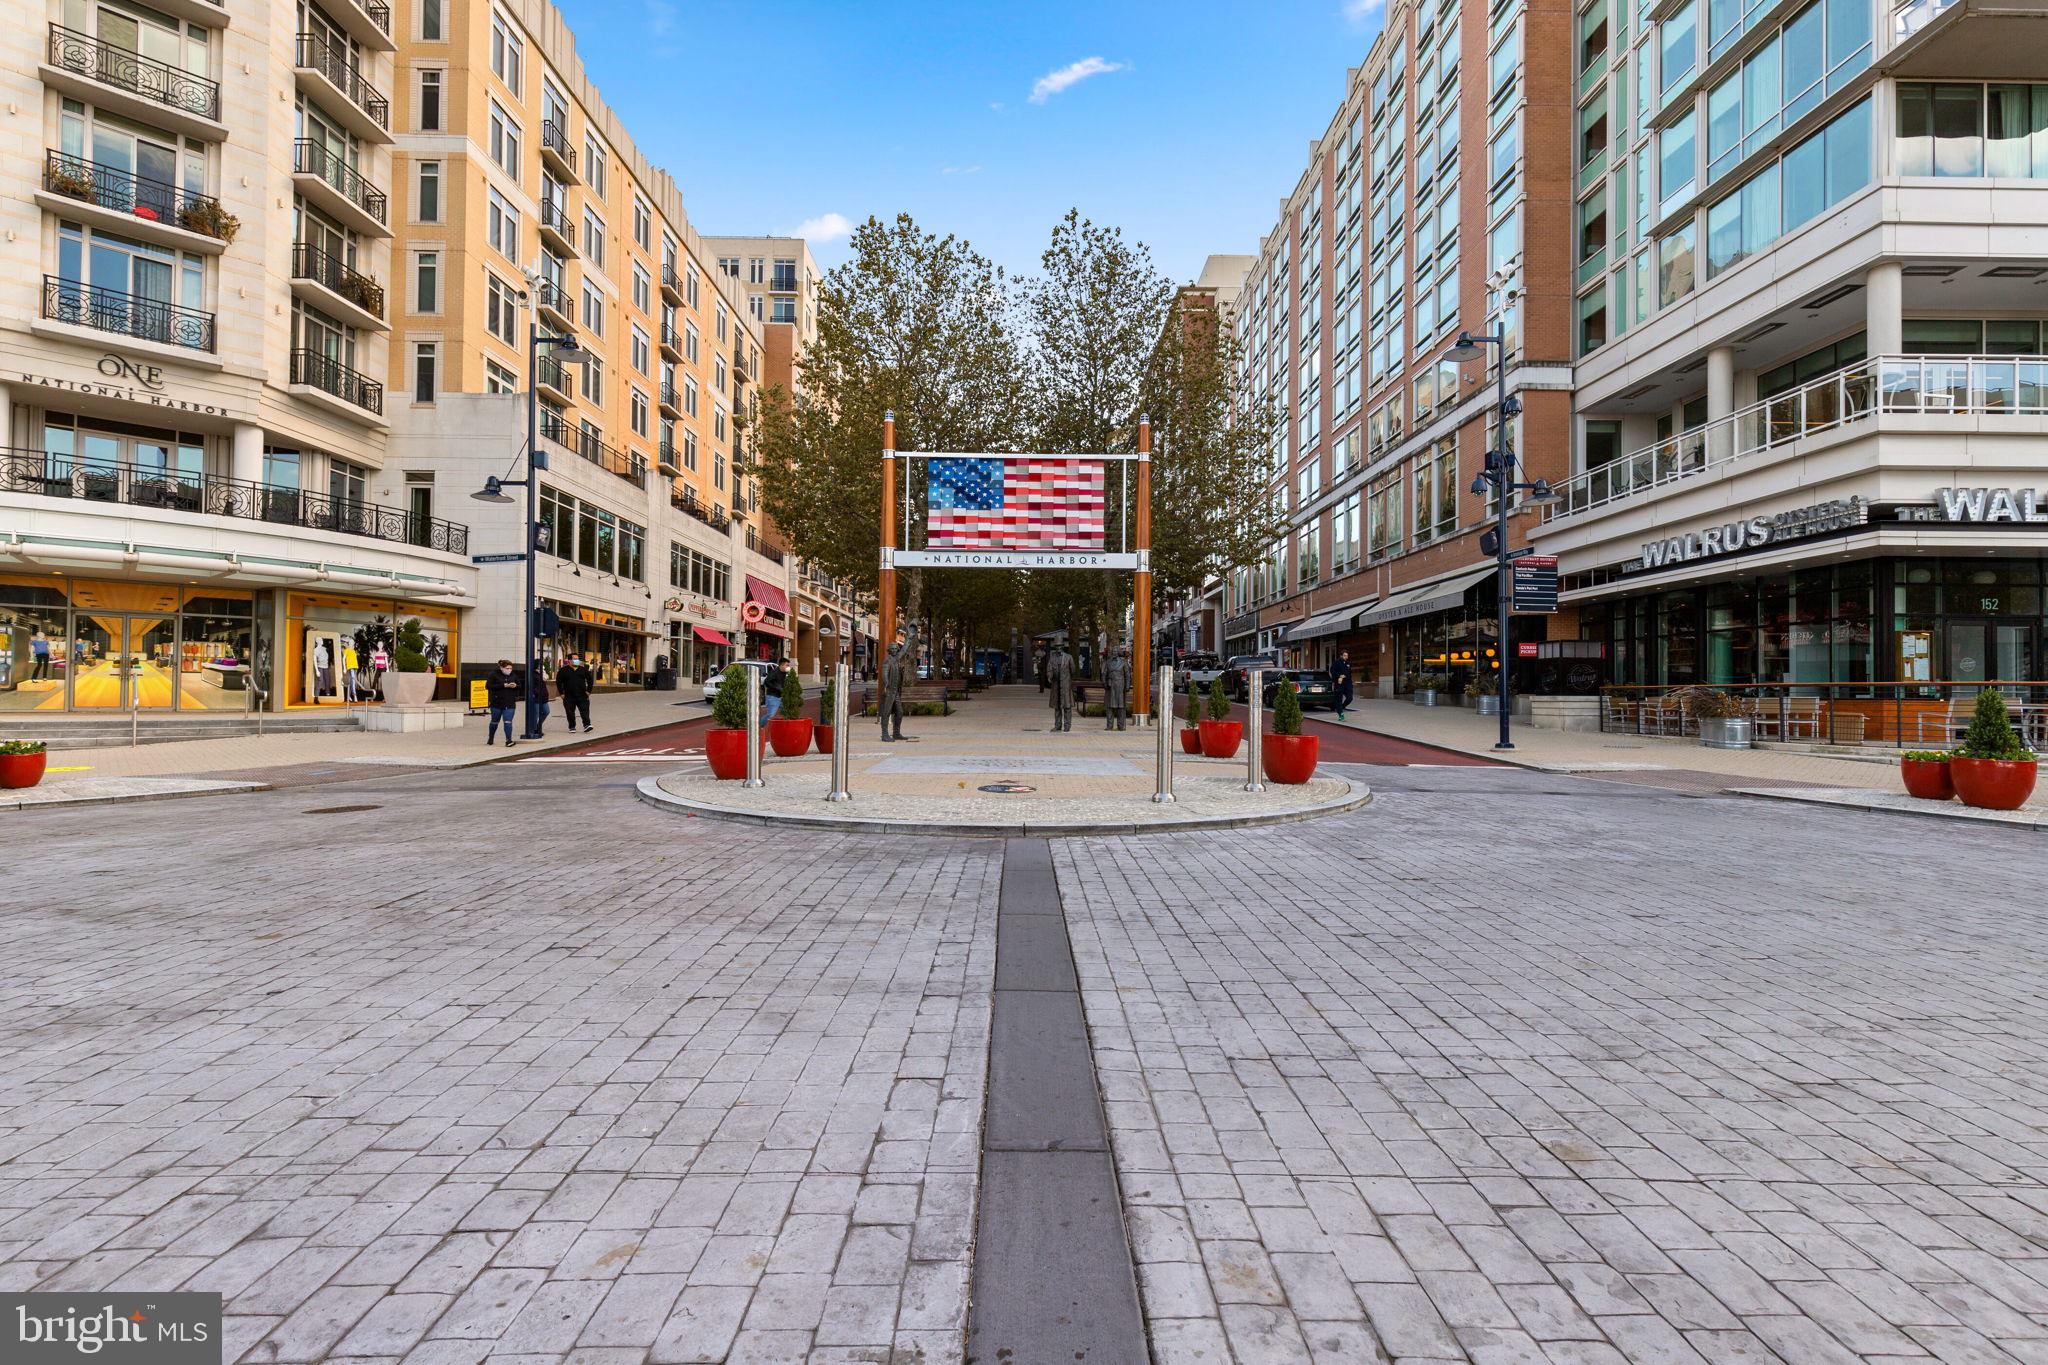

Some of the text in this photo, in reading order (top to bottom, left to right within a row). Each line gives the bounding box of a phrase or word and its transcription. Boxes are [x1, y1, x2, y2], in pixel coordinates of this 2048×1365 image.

[97, 353, 165, 390] ONE
[22, 373, 229, 417] NATIONAL HARBOR
[1775, 500, 1840, 526] OYSTER
[1894, 487, 2048, 522] THE WAL
[933, 555, 1098, 564] NATIONAL HARBOR
[1641, 516, 1772, 569] WALRUS
[1981, 598, 1999, 610] 152
